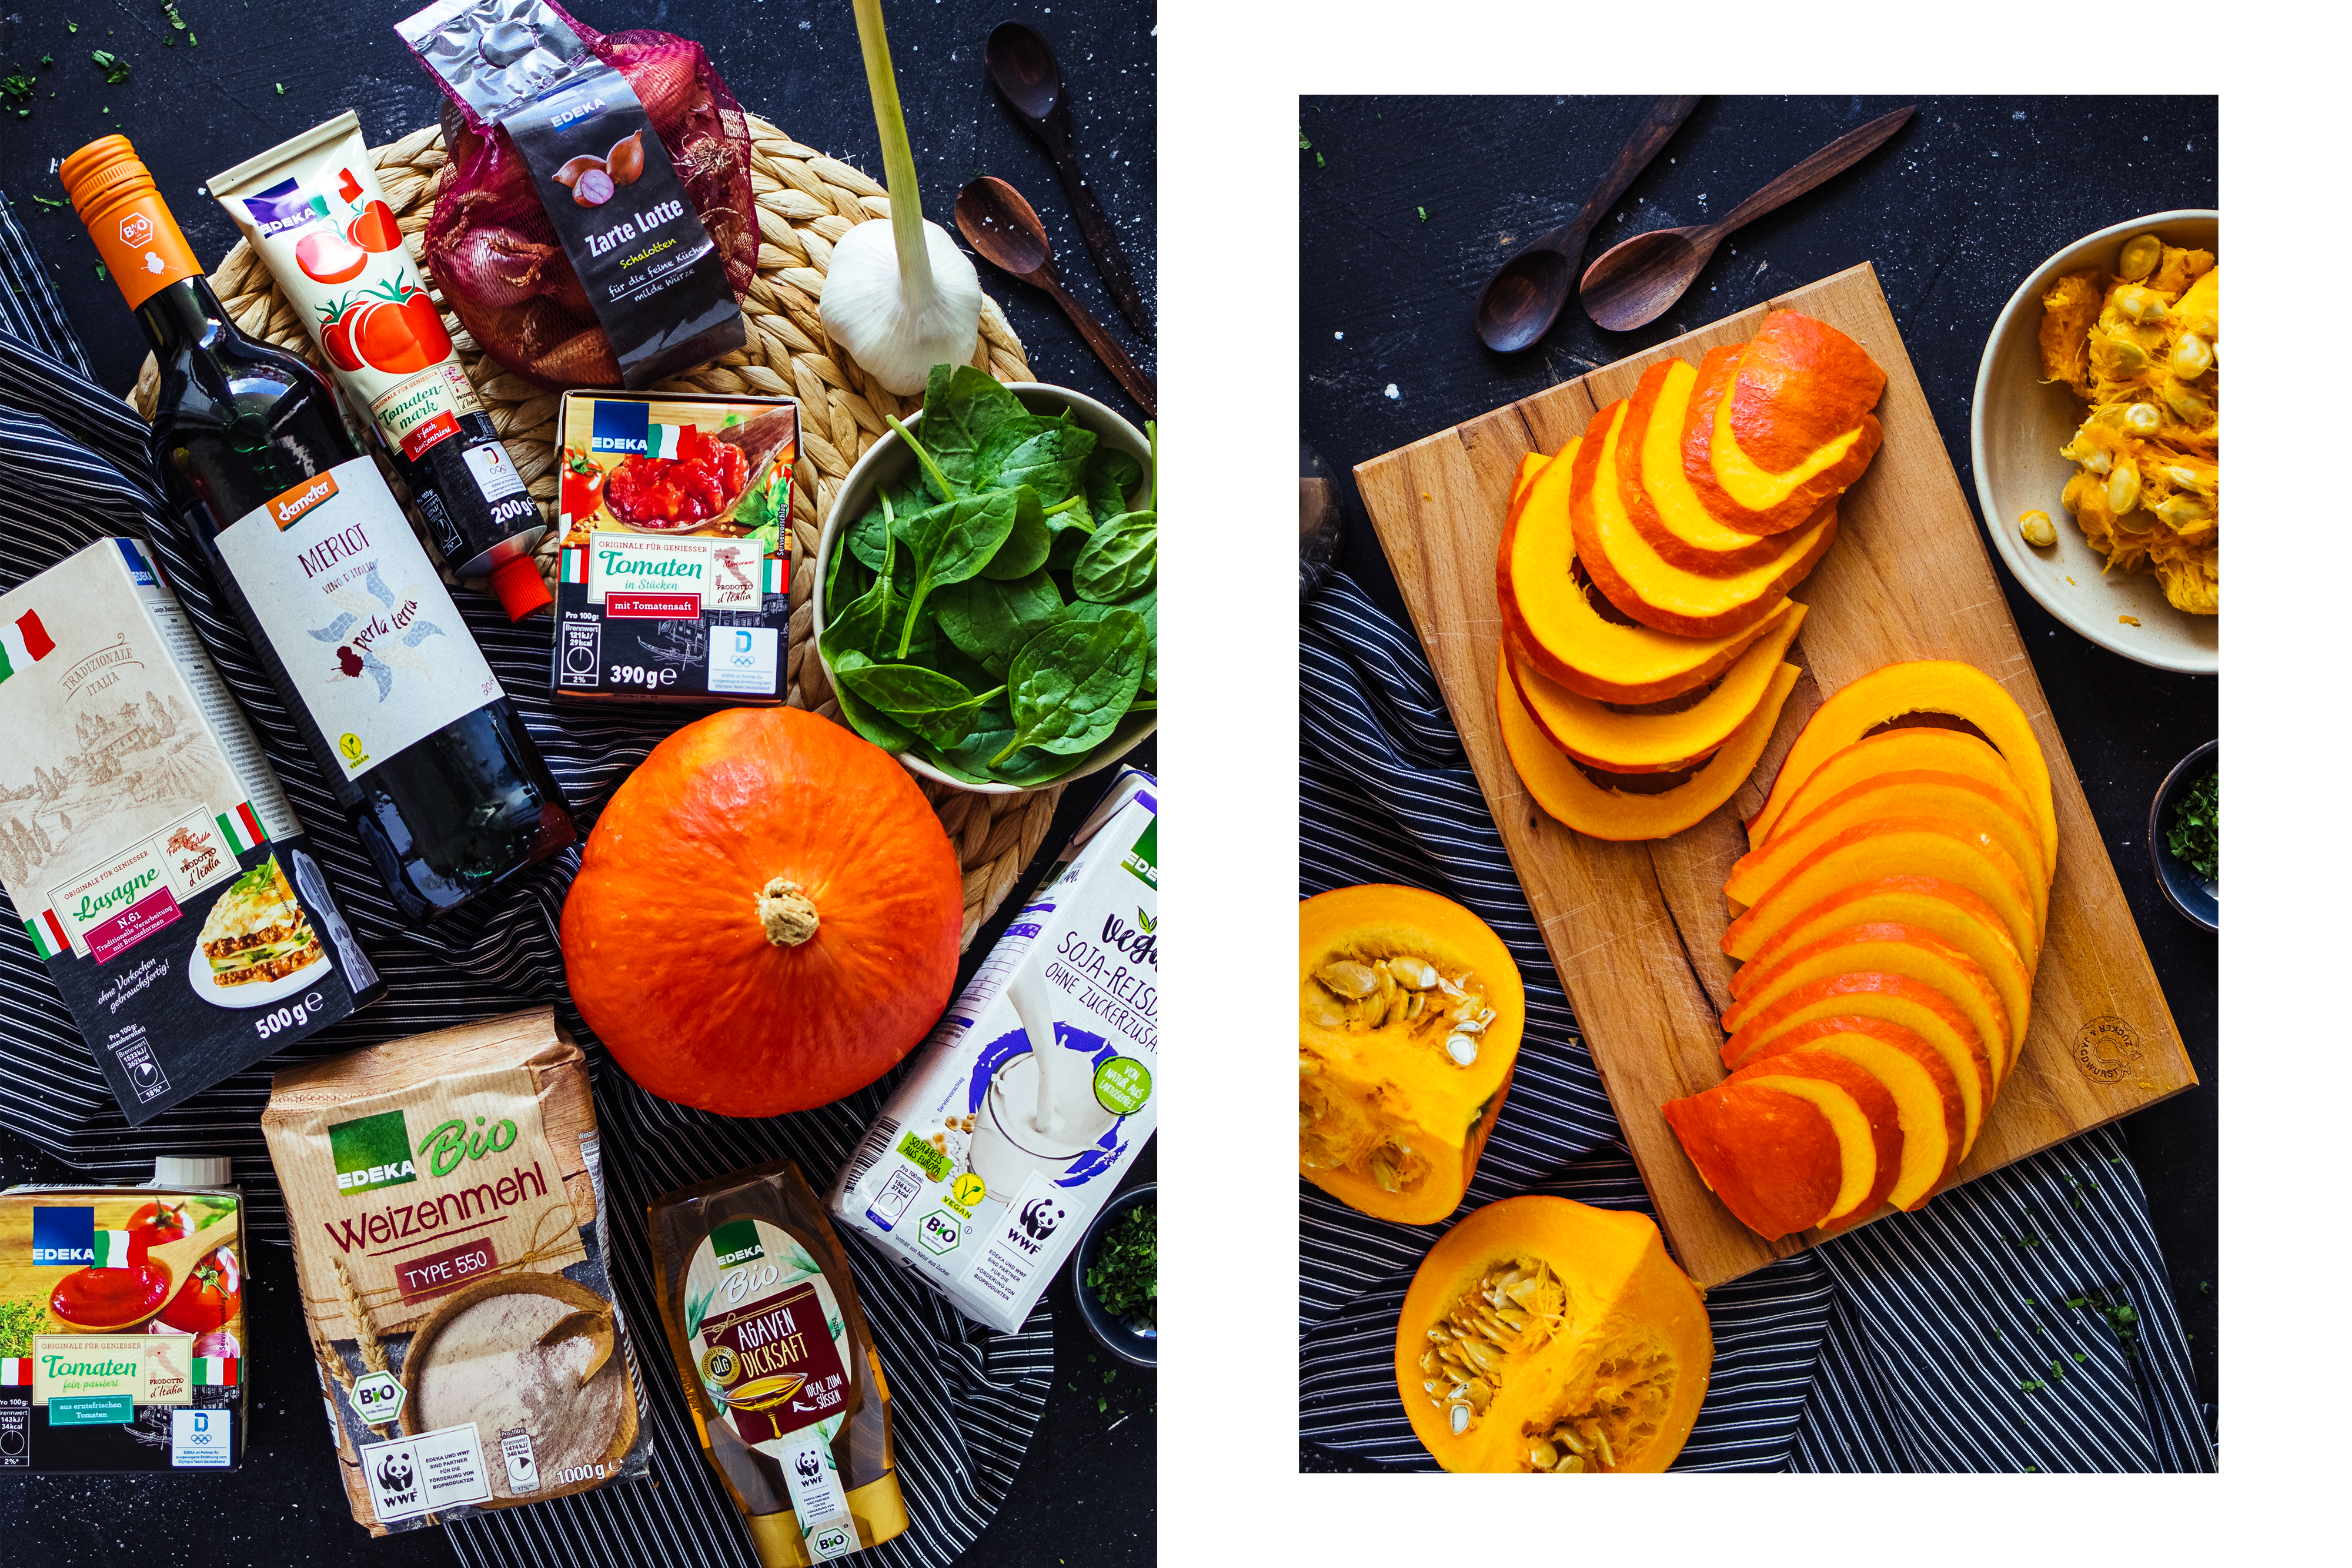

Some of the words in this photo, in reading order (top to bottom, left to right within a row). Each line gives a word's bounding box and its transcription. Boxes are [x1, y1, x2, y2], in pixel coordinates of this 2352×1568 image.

[551, 98, 606, 128] EDEKA
[259, 208, 316, 235] EDEKA
[584, 223, 636, 258] Zarte
[634, 200, 683, 233] Lotte
[620, 238, 677, 269] Schalotten
[609, 283, 625, 297] für
[629, 274, 646, 286] die
[647, 260, 674, 278] feine
[676, 245, 704, 263] Küche
[634, 283, 664, 302] milde
[665, 268, 695, 286] Würze
[373, 392, 397, 412] ORIGINALE
[409, 371, 438, 387] GENIESSER
[378, 385, 443, 426] Tomaten-
[399, 400, 438, 430] mark
[415, 426, 452, 453] konzentriert
[416, 422, 437, 440] 3-fach
[592, 436, 647, 451] EDEKA
[278, 482, 329, 521] demeter
[777, 503, 787, 556] Serviervorschlag
[297, 523, 369, 579] MERLOT
[599, 541, 643, 550] ORIGINALE
[646, 541, 662, 550] FÜR
[663, 544, 707, 553] GENIESSER
[132, 571, 153, 581] EDEKA
[599, 550, 702, 579] Tomaten
[322, 577, 343, 594] VINO
[625, 580, 636, 589] in
[639, 579, 679, 590] Stücken
[717, 590, 751, 604] d'Italia
[615, 601, 630, 610] mit
[632, 601, 691, 611] Tomatensaft
[352, 614, 389, 653] perla
[391, 599, 417, 630] terra
[62, 648, 132, 691] TRADIZIONALE
[85, 671, 120, 697] ITALIA
[482, 676, 495, 696] 2019
[349, 754, 369, 769] VEGAN
[166, 844, 182, 857] Fara
[180, 848, 216, 873] PRODOTTO
[64, 877, 100, 900] ORIGINALE
[99, 870, 113, 881] FÜR
[113, 850, 149, 873] GENIESSER
[189, 858, 221, 887] d'Italia
[1124, 854, 1157, 884] EDE
[73, 868, 160, 922] Lasagne
[270, 877, 292, 916] Serviervorschlag
[96, 927, 134, 952] Traditionelle
[133, 905, 173, 932] Verarbeitung
[117, 911, 141, 929] N.61
[112, 942, 123, 952] mit
[123, 918, 165, 945] Bronzeformen
[98, 988, 116, 1004] ohne
[115, 958, 156, 989] Vorkochen
[111, 958, 169, 1014] gebrauchsfertig!
[1057, 931, 1157, 1022] SOJA-REISD
[1045, 962, 1080, 994] OHNE
[1079, 986, 1157, 1054] ZUCKERZUSA
[107, 1026, 146, 1051] (unzubereitet)
[118, 1041, 146, 1058] Brennwert
[2099, 1025, 2133, 1047] ZUCKER
[2080, 1037, 2119, 1078] JAGDWURST
[1105, 1068, 1129, 1089] NATUR
[1127, 1084, 1145, 1099] AUS
[1124, 1065, 1141, 1081] VON
[937, 1076, 965, 1113] Serviervorschlag
[1098, 1079, 1137, 1109] LAKTOSEFREI
[418, 1116, 516, 1176] Bio
[909, 1136, 944, 1165] SOJA&REIS
[337, 1160, 416, 1189] EDEKA
[903, 1146, 917, 1159] AUS
[917, 1155, 941, 1176] EUROPA
[896, 1173, 918, 1191] Brennwert
[324, 1161, 547, 1253] Weizenmehl
[943, 1195, 972, 1219] VEGAN
[33, 1248, 95, 1261] EDEKA
[1008, 1228, 1041, 1255] WWF
[716, 1245, 764, 1266] EDEKA
[917, 1251, 929, 1261] Natur
[936, 1264, 950, 1276] Zucker
[988, 1249, 1005, 1263] EDEKA
[1005, 1261, 1015, 1270] UND
[1015, 1268, 1027, 1278] WWF
[405, 1261, 453, 1288] TYPE
[456, 1251, 487, 1275] 550
[976, 1266, 1005, 1288] FÖRDERUNG
[1005, 1286, 1015, 1296] VON
[988, 1257, 999, 1267] SIND
[999, 1265, 1020, 1282] PARTNER
[991, 1268, 1001, 1277] FÜR
[1000, 1275, 1009, 1283] DIE
[719, 1265, 779, 1304] Bio
[974, 1273, 1010, 1300] BIOPRODUKTEN
[219, 1297, 228, 1350] Serviervorschlag
[737, 1308, 797, 1351] AGAVEN
[42, 1355, 137, 1378] Tomaten
[704, 1349, 717, 1374] GOLDENER
[718, 1348, 731, 1356] PREIS
[713, 1354, 730, 1373] DLG
[740, 1332, 808, 1378] DICKSAFT
[63, 1379, 82, 1392] fein
[83, 1379, 119, 1391] passiert
[151, 1386, 183, 1399] d'Italia
[805, 1380, 826, 1398] IDEAL
[826, 1373, 842, 1389] ZUM
[816, 1389, 841, 1409] SÜSSEN
[74, 1402, 122, 1410] erntefrischen
[503, 1437, 528, 1446] Brennwert
[426, 1455, 444, 1463] EDEKA
[443, 1457, 468, 1467] PARTNER
[429, 1473, 462, 1483] FÖRDERUNG
[433, 1477, 474, 1489] BIOPRODUKTEN
[801, 1475, 823, 1487] WWF
[384, 1491, 417, 1508] WWF
[809, 1508, 835, 1518] BIOPRODUKTEN
